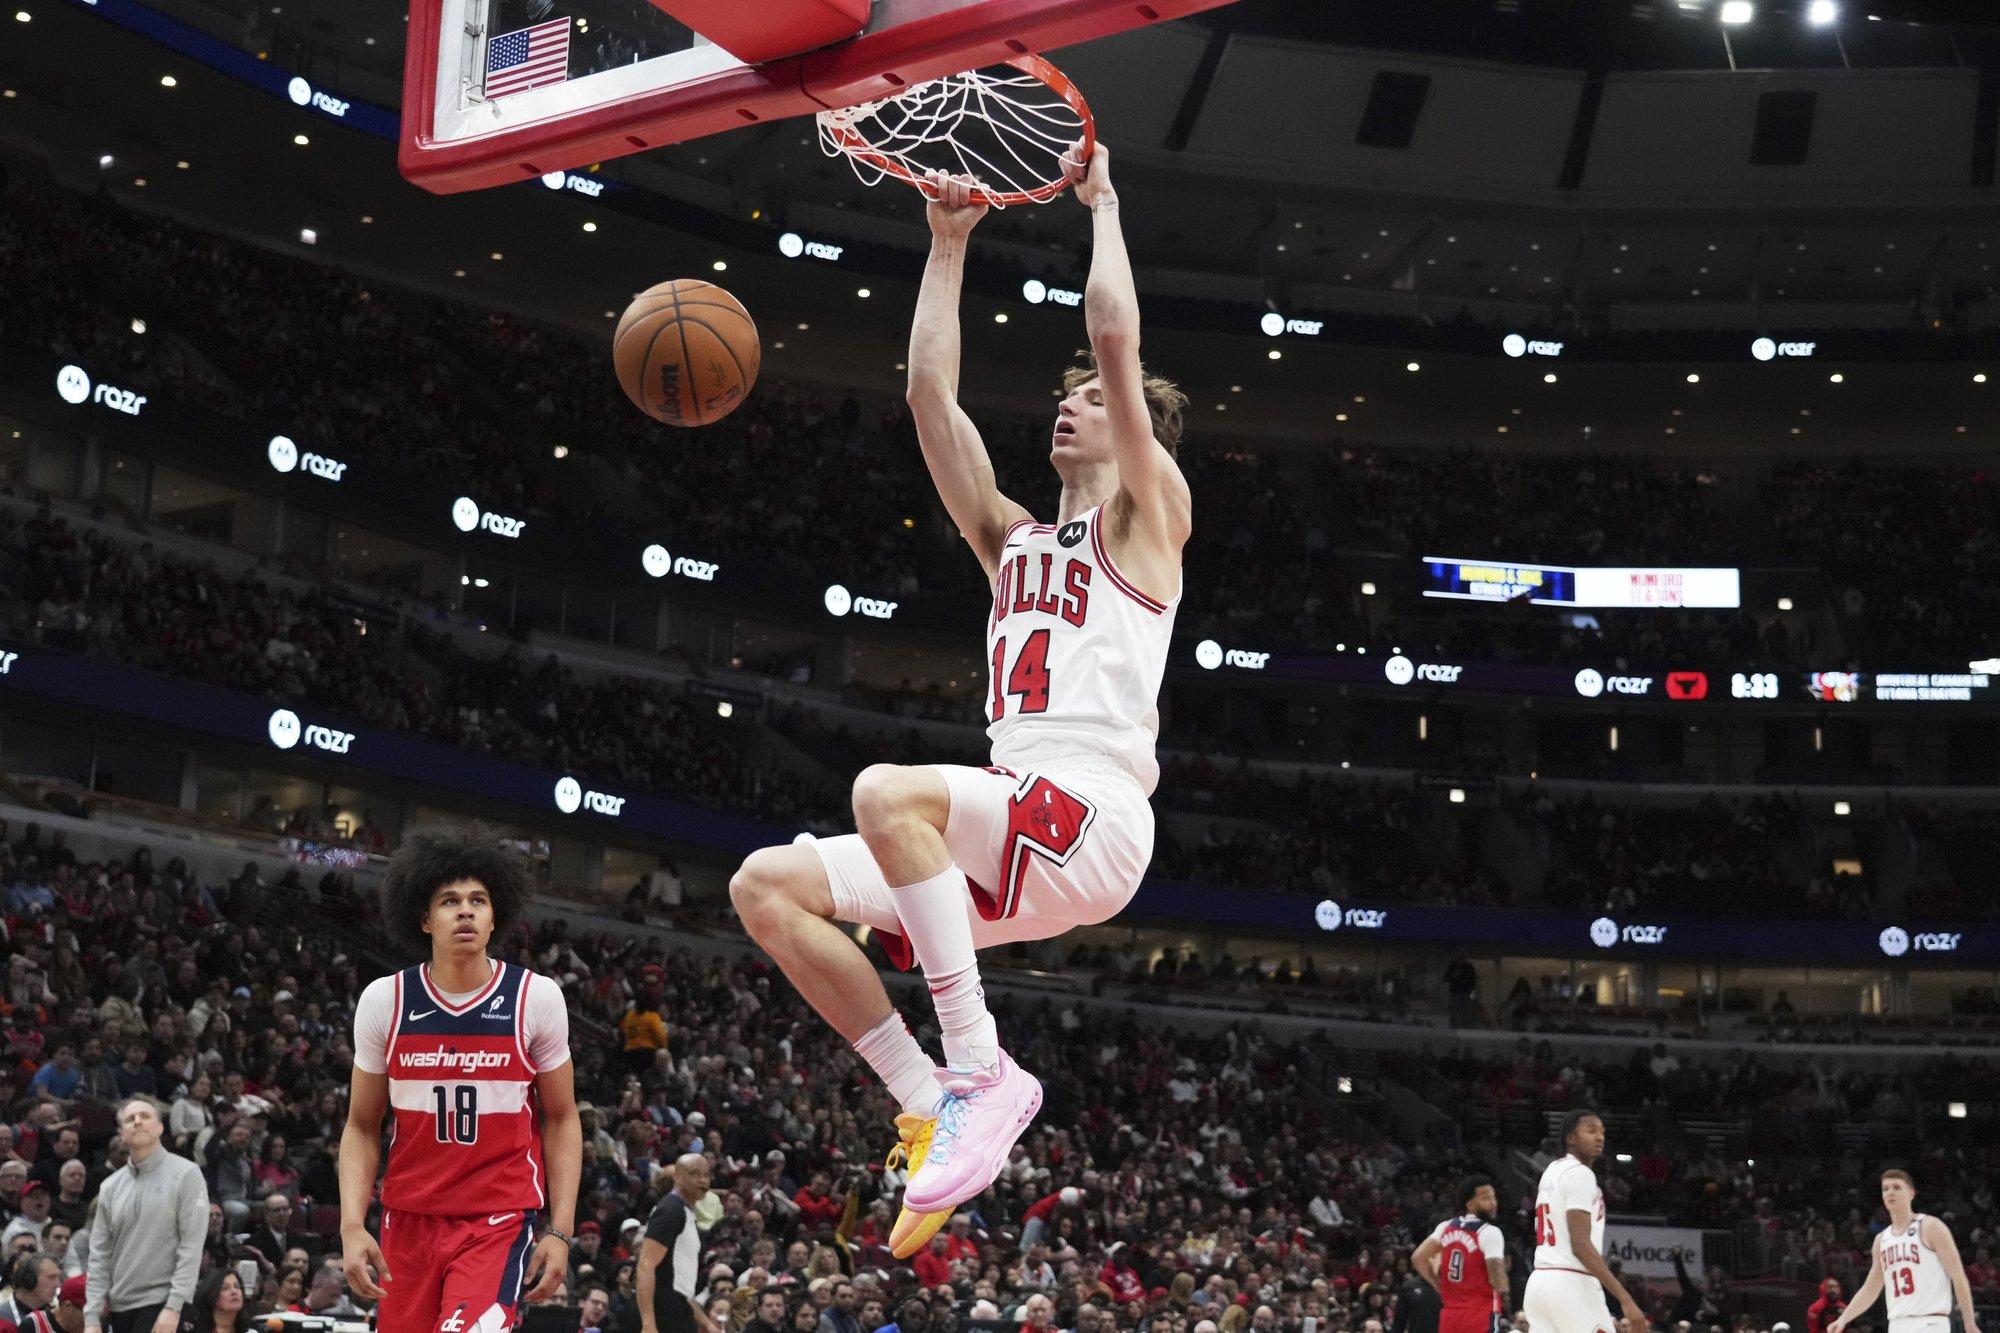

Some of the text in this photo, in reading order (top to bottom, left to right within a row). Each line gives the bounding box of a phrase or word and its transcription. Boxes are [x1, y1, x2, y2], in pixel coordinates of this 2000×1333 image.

[312, 89, 350, 117] razr
[566, 174, 605, 197] razr
[804, 241, 844, 261] razr
[1047, 287, 1084, 307] razr
[1287, 319, 1324, 336] razr
[1527, 340, 1564, 357] razr
[1778, 341, 1816, 357] razr
[94, 383, 148, 416] razr
[300, 451, 348, 482] razr
[480, 511, 526, 539] razr
[673, 556, 720, 582] razr
[853, 596, 899, 619] razr
[1225, 649, 1271, 670] razr
[991, 628, 1051, 724] 14
[1416, 663, 1463, 683] razr
[1606, 676, 1653, 695] razr
[304, 724, 356, 754] razr
[583, 790, 626, 817] razr
[1344, 908, 1387, 928] razr
[1622, 924, 1667, 944] razr
[1913, 932, 1961, 951] razr
[399, 1043, 511, 1073] washington
[432, 1084, 478, 1145] 18
[1607, 1240, 1696, 1263] Advocae
[1448, 1249, 1464, 1283] 9
[1892, 1267, 1915, 1298] 13
